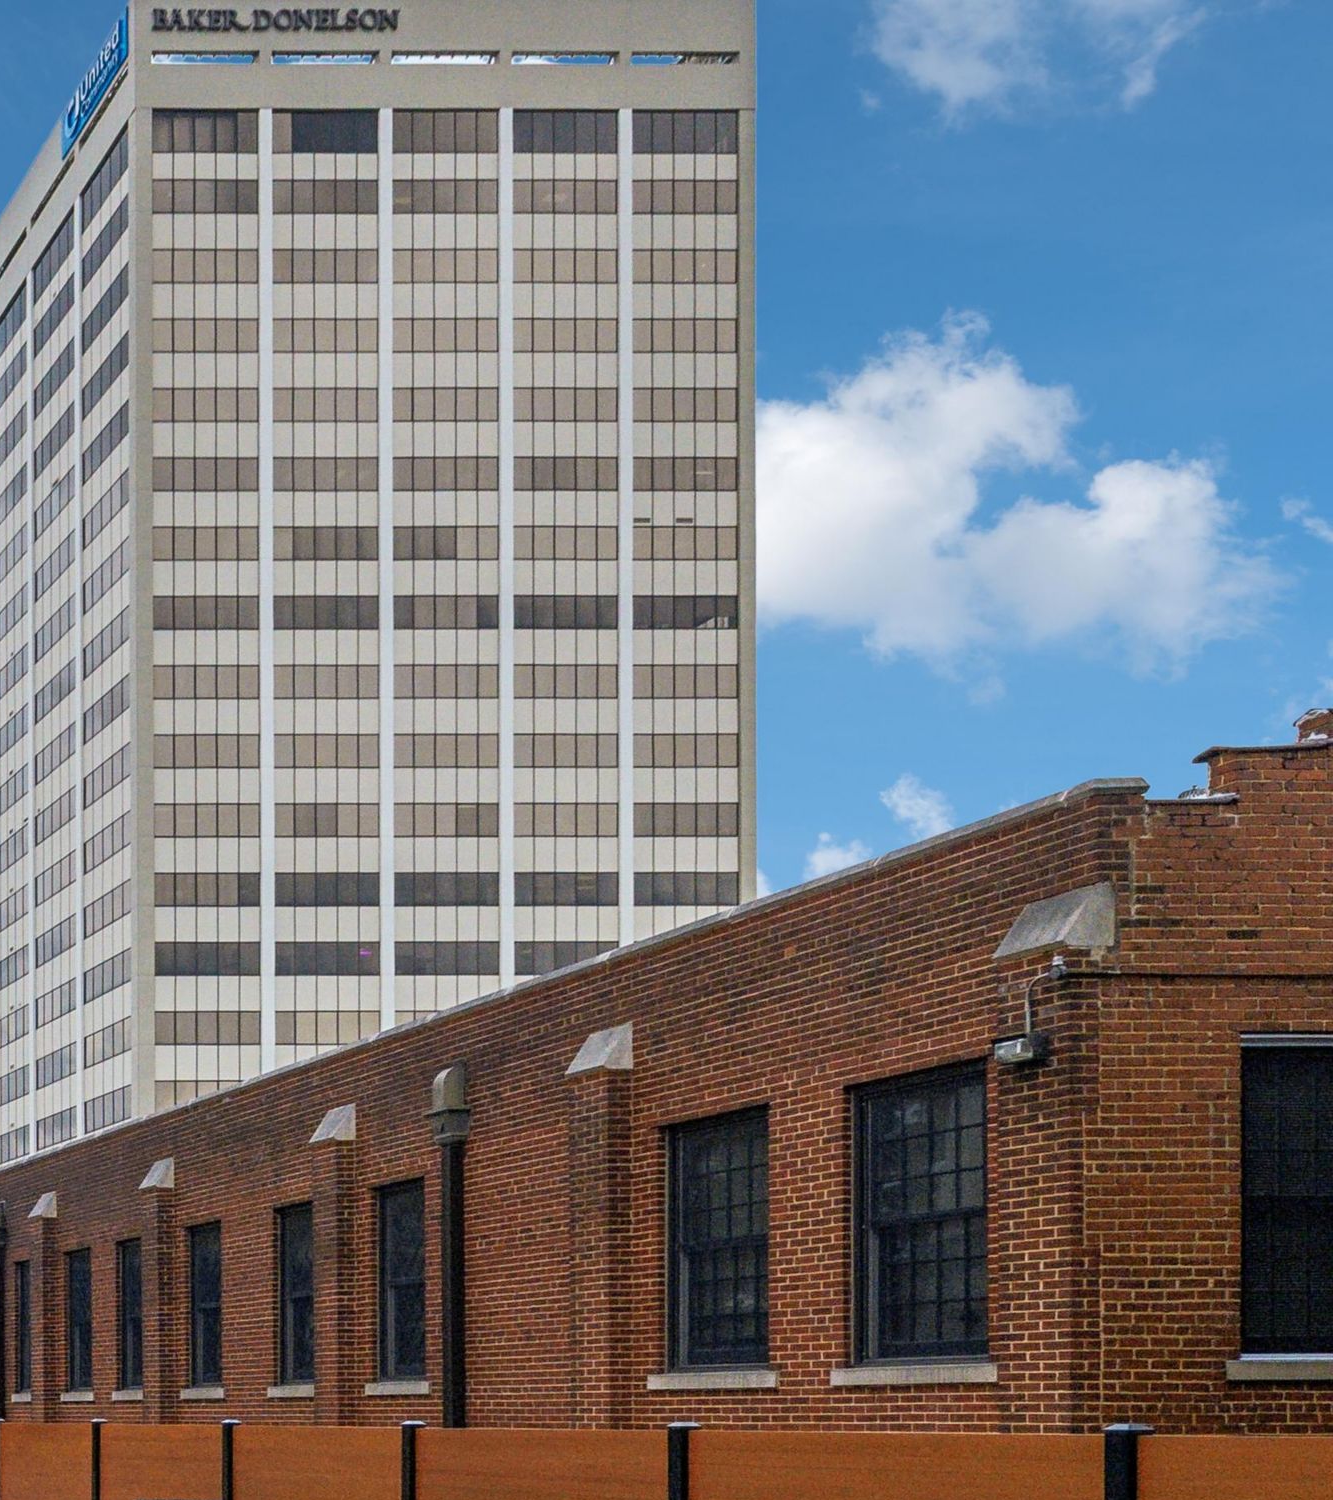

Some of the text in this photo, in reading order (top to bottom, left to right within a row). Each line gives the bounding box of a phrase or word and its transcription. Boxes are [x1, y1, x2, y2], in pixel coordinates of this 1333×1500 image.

[151, 8, 400, 32] BAKER DONELSON
[79, 19, 120, 99] United
